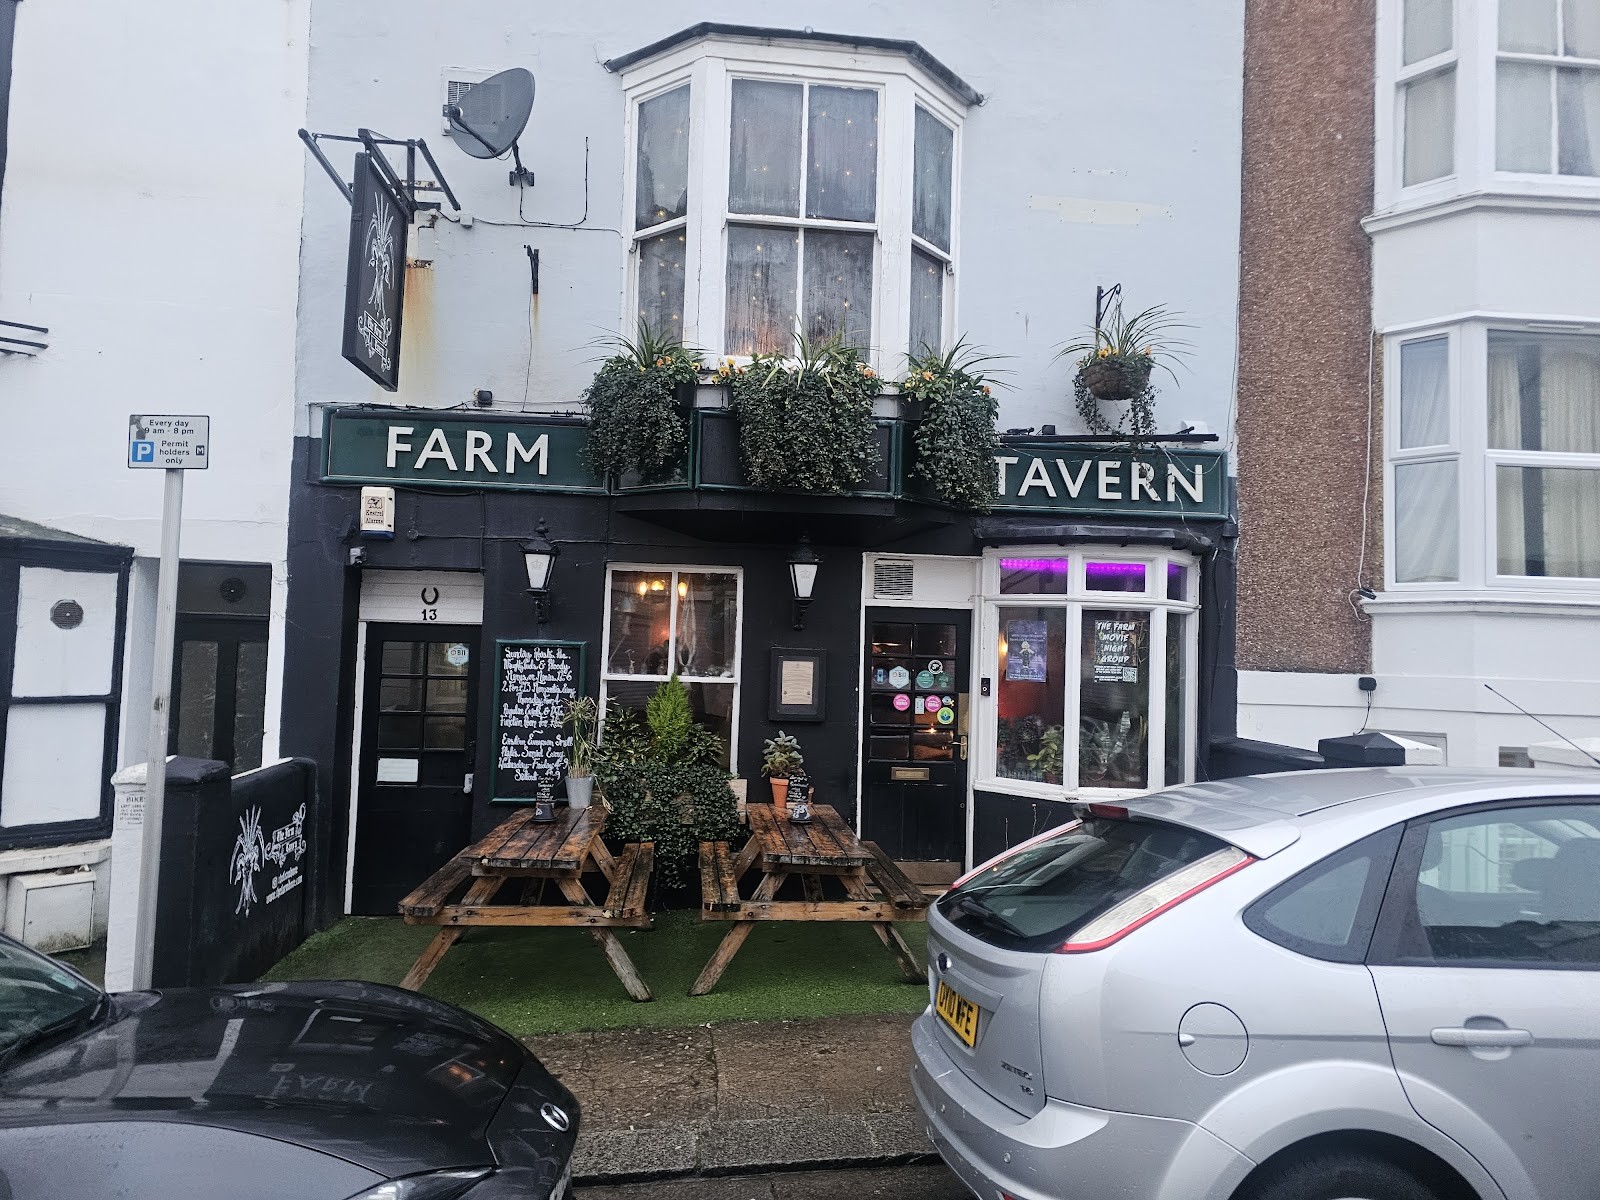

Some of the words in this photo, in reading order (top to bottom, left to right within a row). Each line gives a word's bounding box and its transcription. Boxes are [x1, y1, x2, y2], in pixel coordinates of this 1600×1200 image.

[150, 419, 172, 427] Every
[175, 420, 189, 428] day
[137, 443, 151, 460] P
[386, 426, 548, 476] FARM
[994, 456, 1204, 503] TAVERN
[421, 608, 437, 621] 13
[1097, 621, 1110, 630] THE
[1113, 622, 1135, 631] FARM
[1103, 634, 1129, 642] MOVIE
[505, 647, 532, 659] Sunday
[1103, 644, 1128, 653] NIGHT
[1101, 655, 1129, 663] GROUP
[539, 660, 547, 670] &
[502, 681, 509, 692] 2
